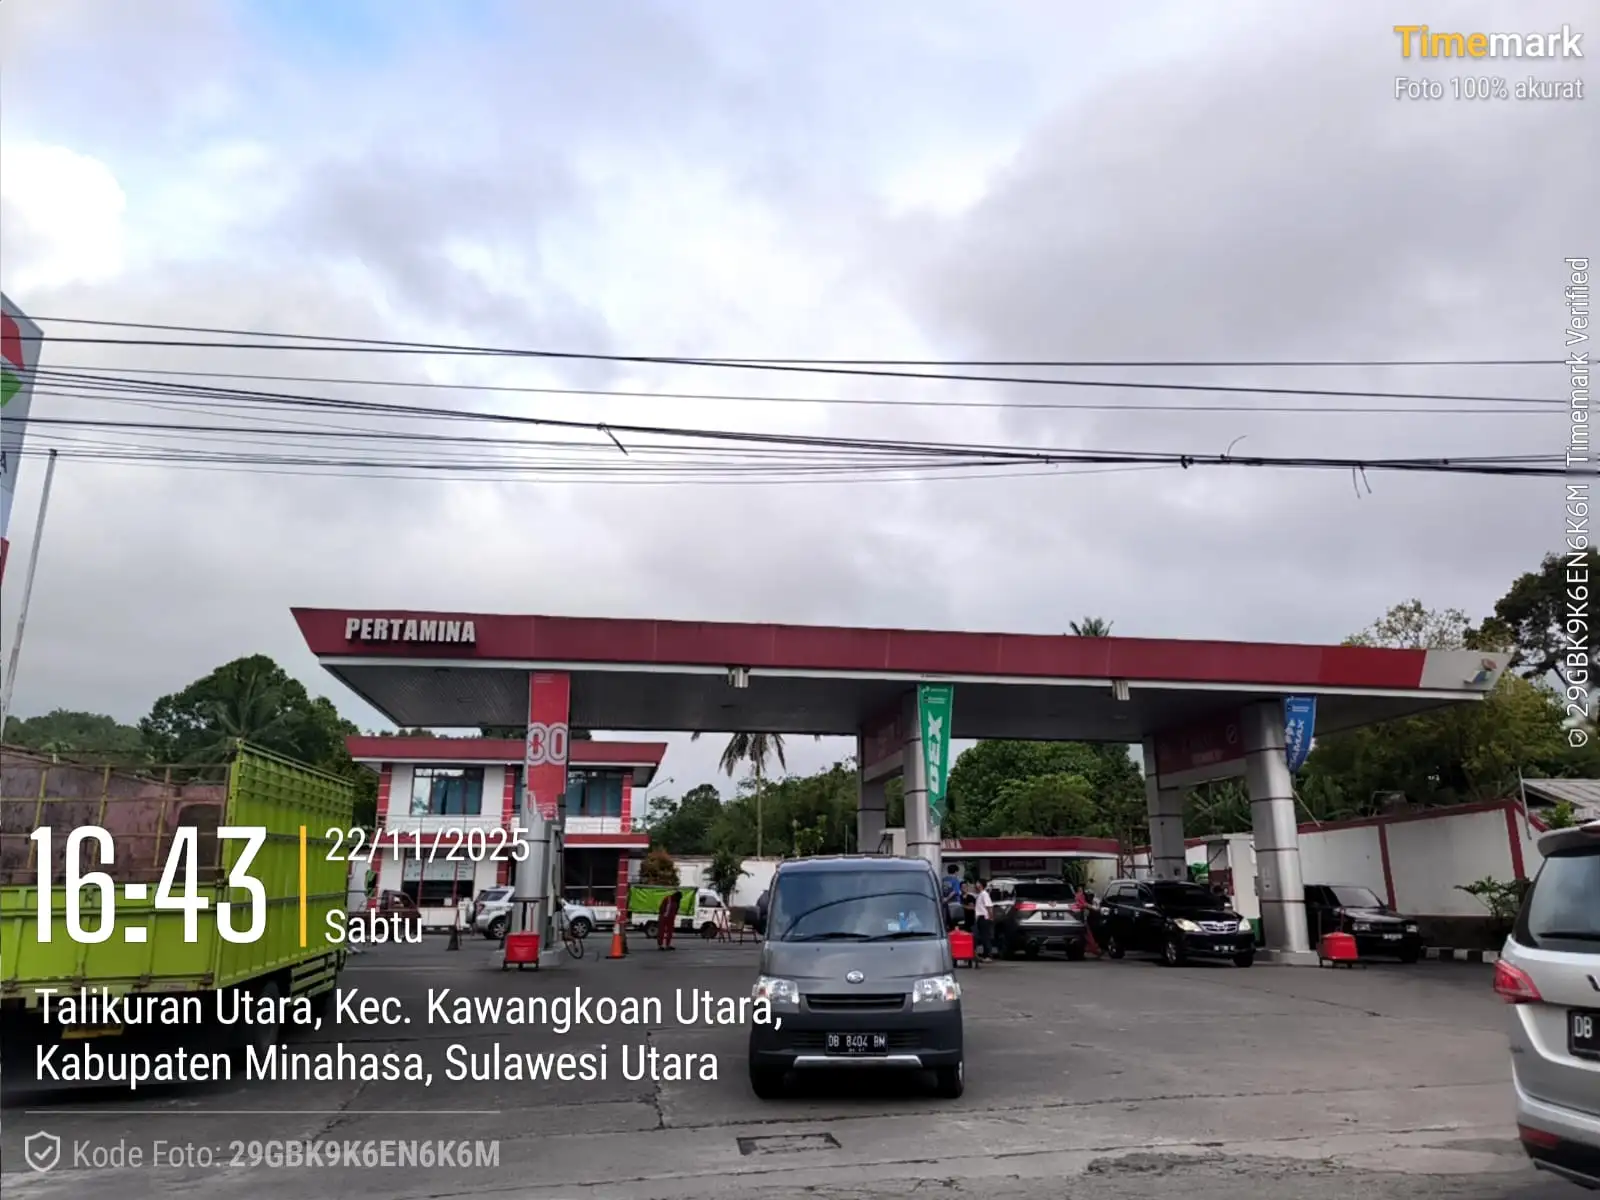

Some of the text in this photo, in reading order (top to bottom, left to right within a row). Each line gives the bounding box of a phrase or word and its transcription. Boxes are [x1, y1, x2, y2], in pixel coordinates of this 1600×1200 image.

[345, 617, 476, 642] PERTAMINA
[927, 710, 943, 795] DEX
[1574, 1015, 1593, 1038] DB
[828, 1034, 840, 1048] DB
